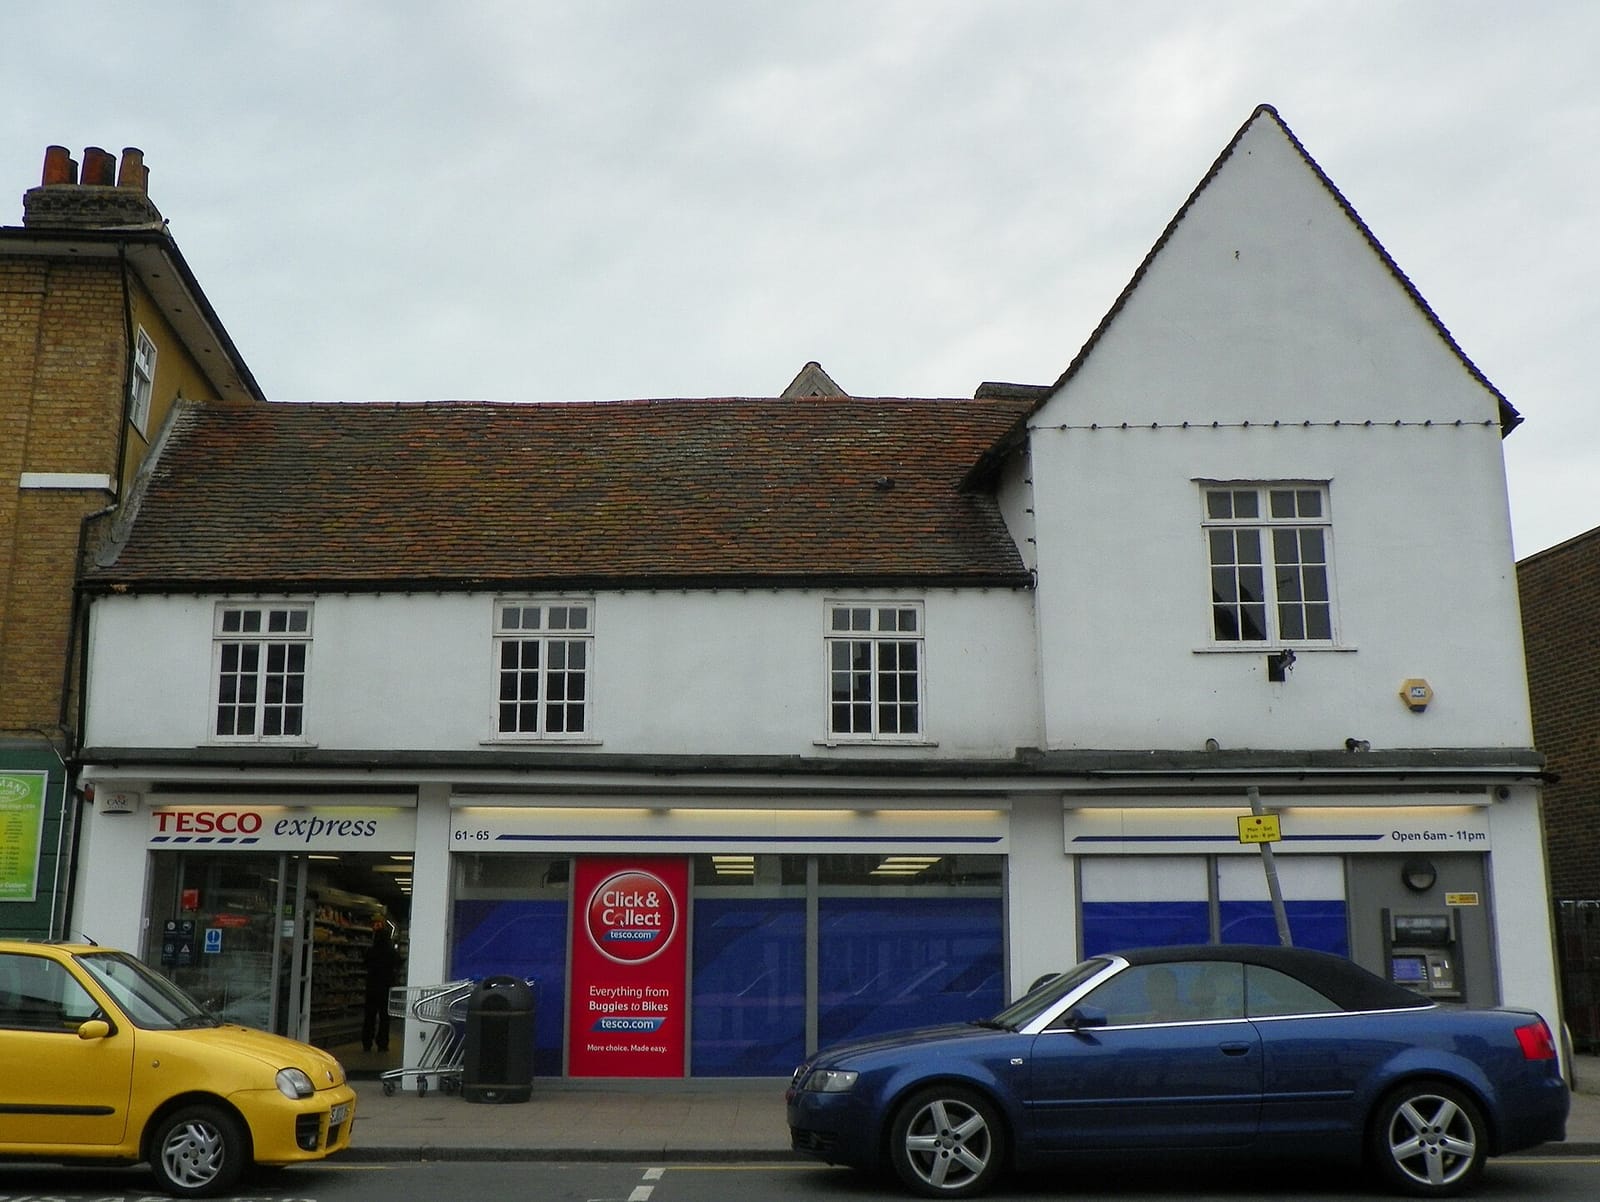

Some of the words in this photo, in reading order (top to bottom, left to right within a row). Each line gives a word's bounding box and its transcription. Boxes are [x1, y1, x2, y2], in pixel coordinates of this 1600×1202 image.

[151, 811, 264, 834] TESCO
[273, 815, 378, 844] express
[455, 830, 468, 841] 61
[476, 830, 489, 841] 65
[1391, 830, 1421, 843] Open
[1422, 830, 1448, 841] 6am
[1456, 830, 1486, 843] 11pm
[602, 890, 645, 908] Click
[645, 890, 660, 908] &
[602, 908, 661, 927] Collect
[609, 930, 652, 940] tesco.com
[589, 985, 643, 999] Everything
[645, 986, 670, 997] from
[588, 1000, 629, 1013] Buggies
[630, 1002, 641, 1012] to
[641, 1001, 669, 1012] Bikes
[600, 1019, 654, 1029] tesco.com
[586, 1043, 605, 1053] More
[605, 1043, 630, 1053] choice.
[630, 1043, 650, 1053] Made
[650, 1046, 668, 1054] easy.
